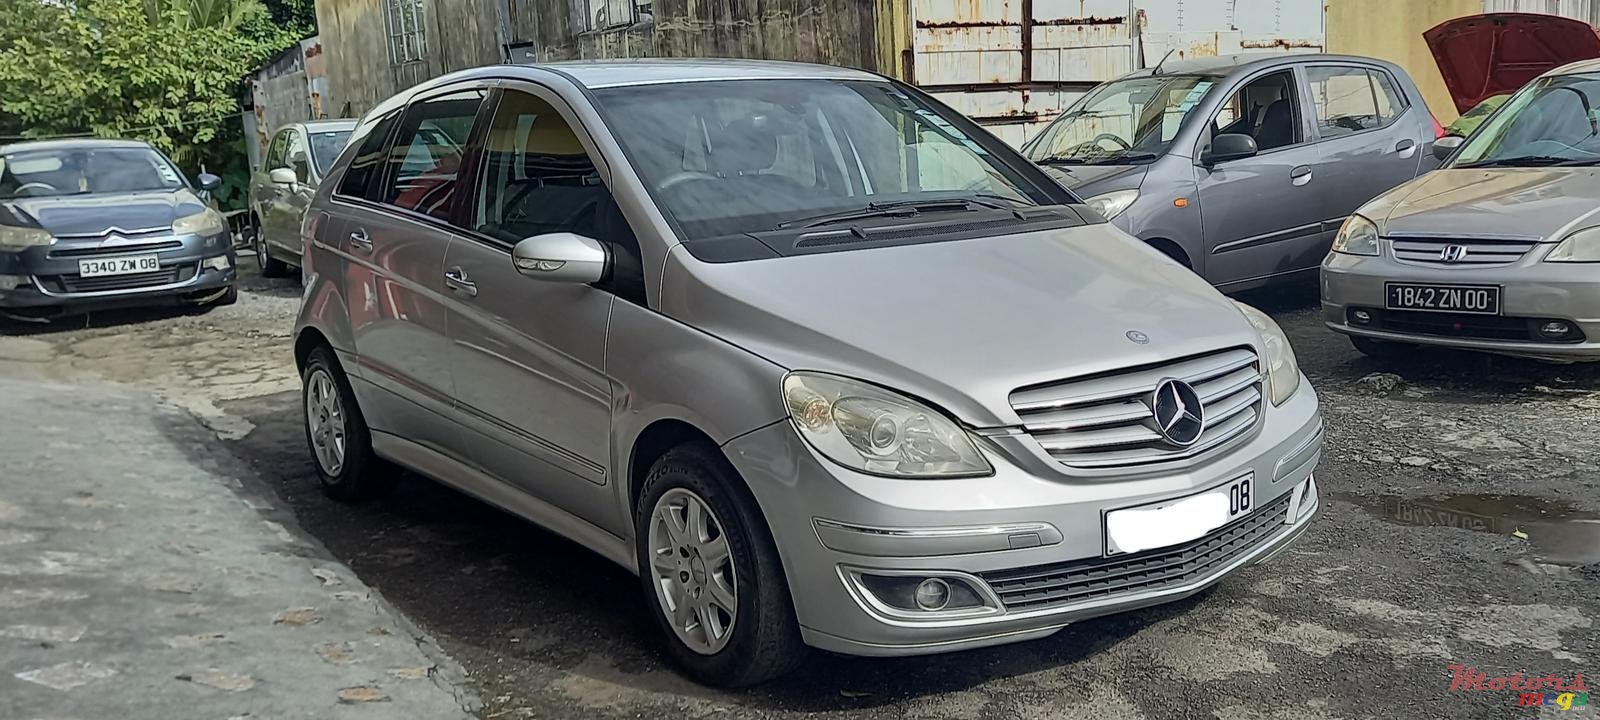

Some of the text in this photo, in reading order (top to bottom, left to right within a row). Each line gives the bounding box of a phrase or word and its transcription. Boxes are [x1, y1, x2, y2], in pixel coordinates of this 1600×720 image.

[81, 258, 157, 274] 3340 ZW 08
[1395, 287, 1488, 309] 1842 ZN 00
[1230, 479, 1250, 516] 08
